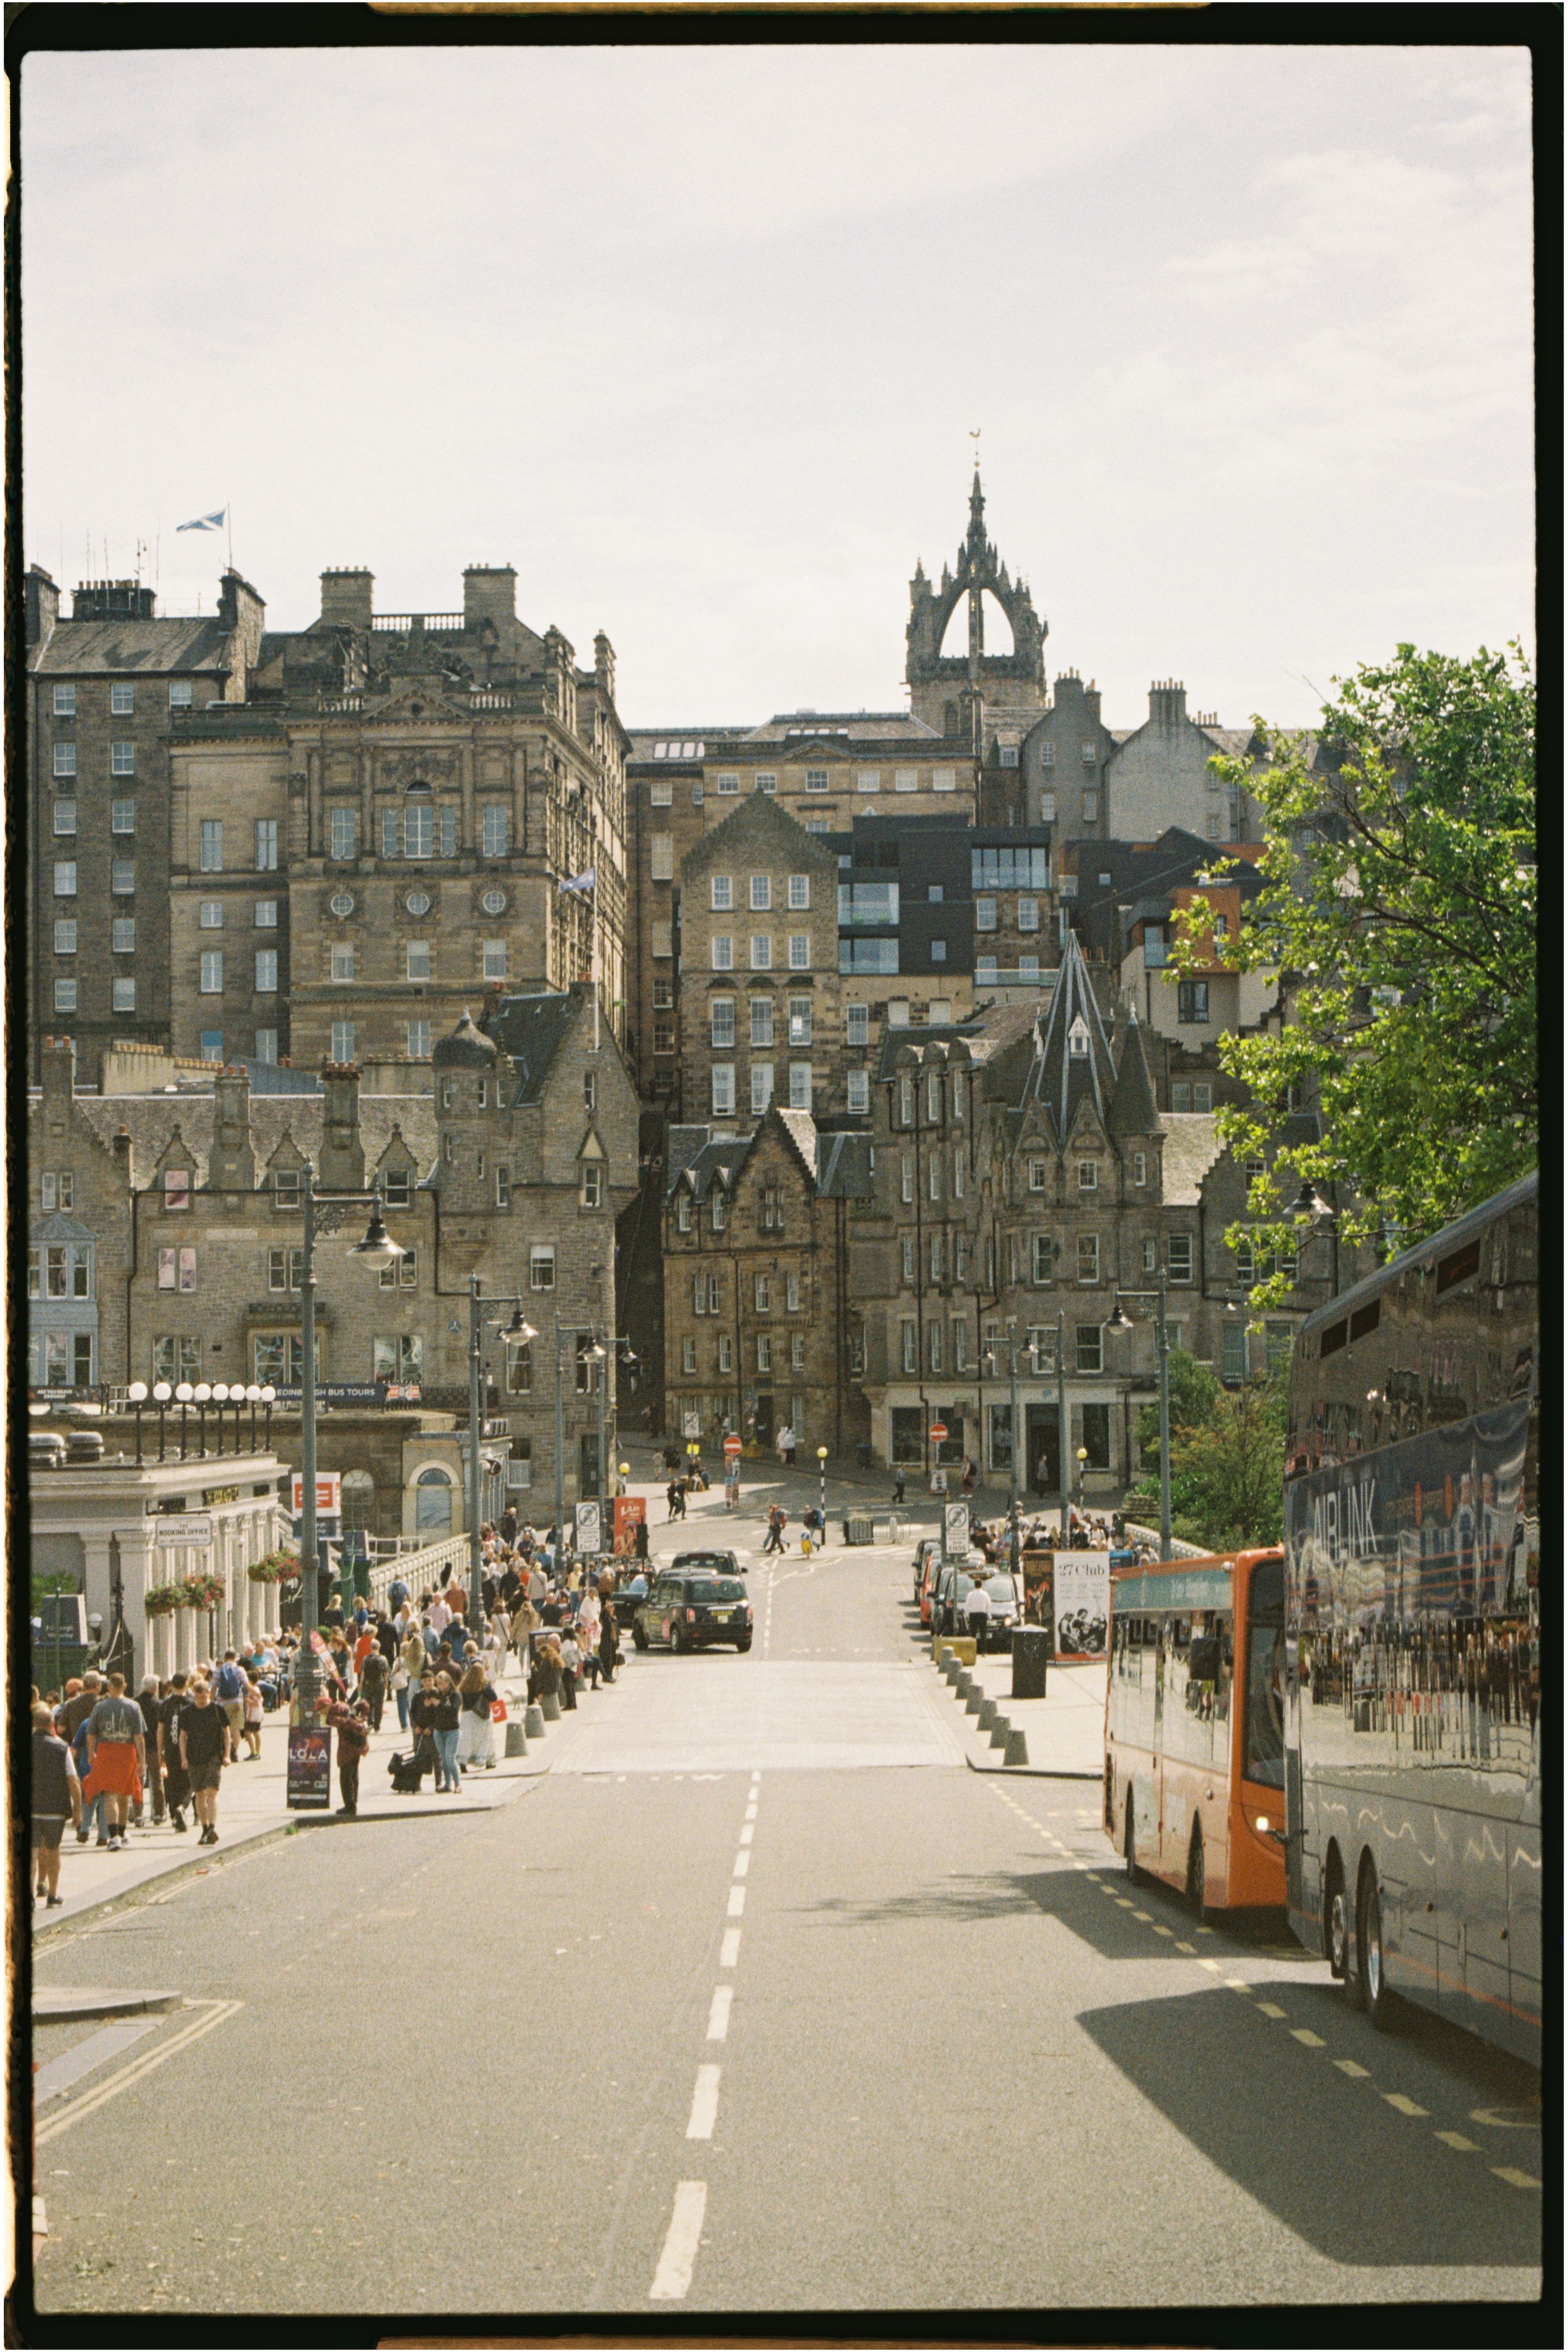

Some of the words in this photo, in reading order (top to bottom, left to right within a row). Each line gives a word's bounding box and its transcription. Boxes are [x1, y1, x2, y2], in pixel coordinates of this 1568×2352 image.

[277, 1388, 326, 1396] EDINBGH
[328, 1388, 344, 1396] BUS
[347, 1388, 376, 1396] TOURS
[1059, 1564, 1074, 1576] 27
[1076, 1564, 1104, 1576] Club
[289, 1747, 328, 1760] LOLA
